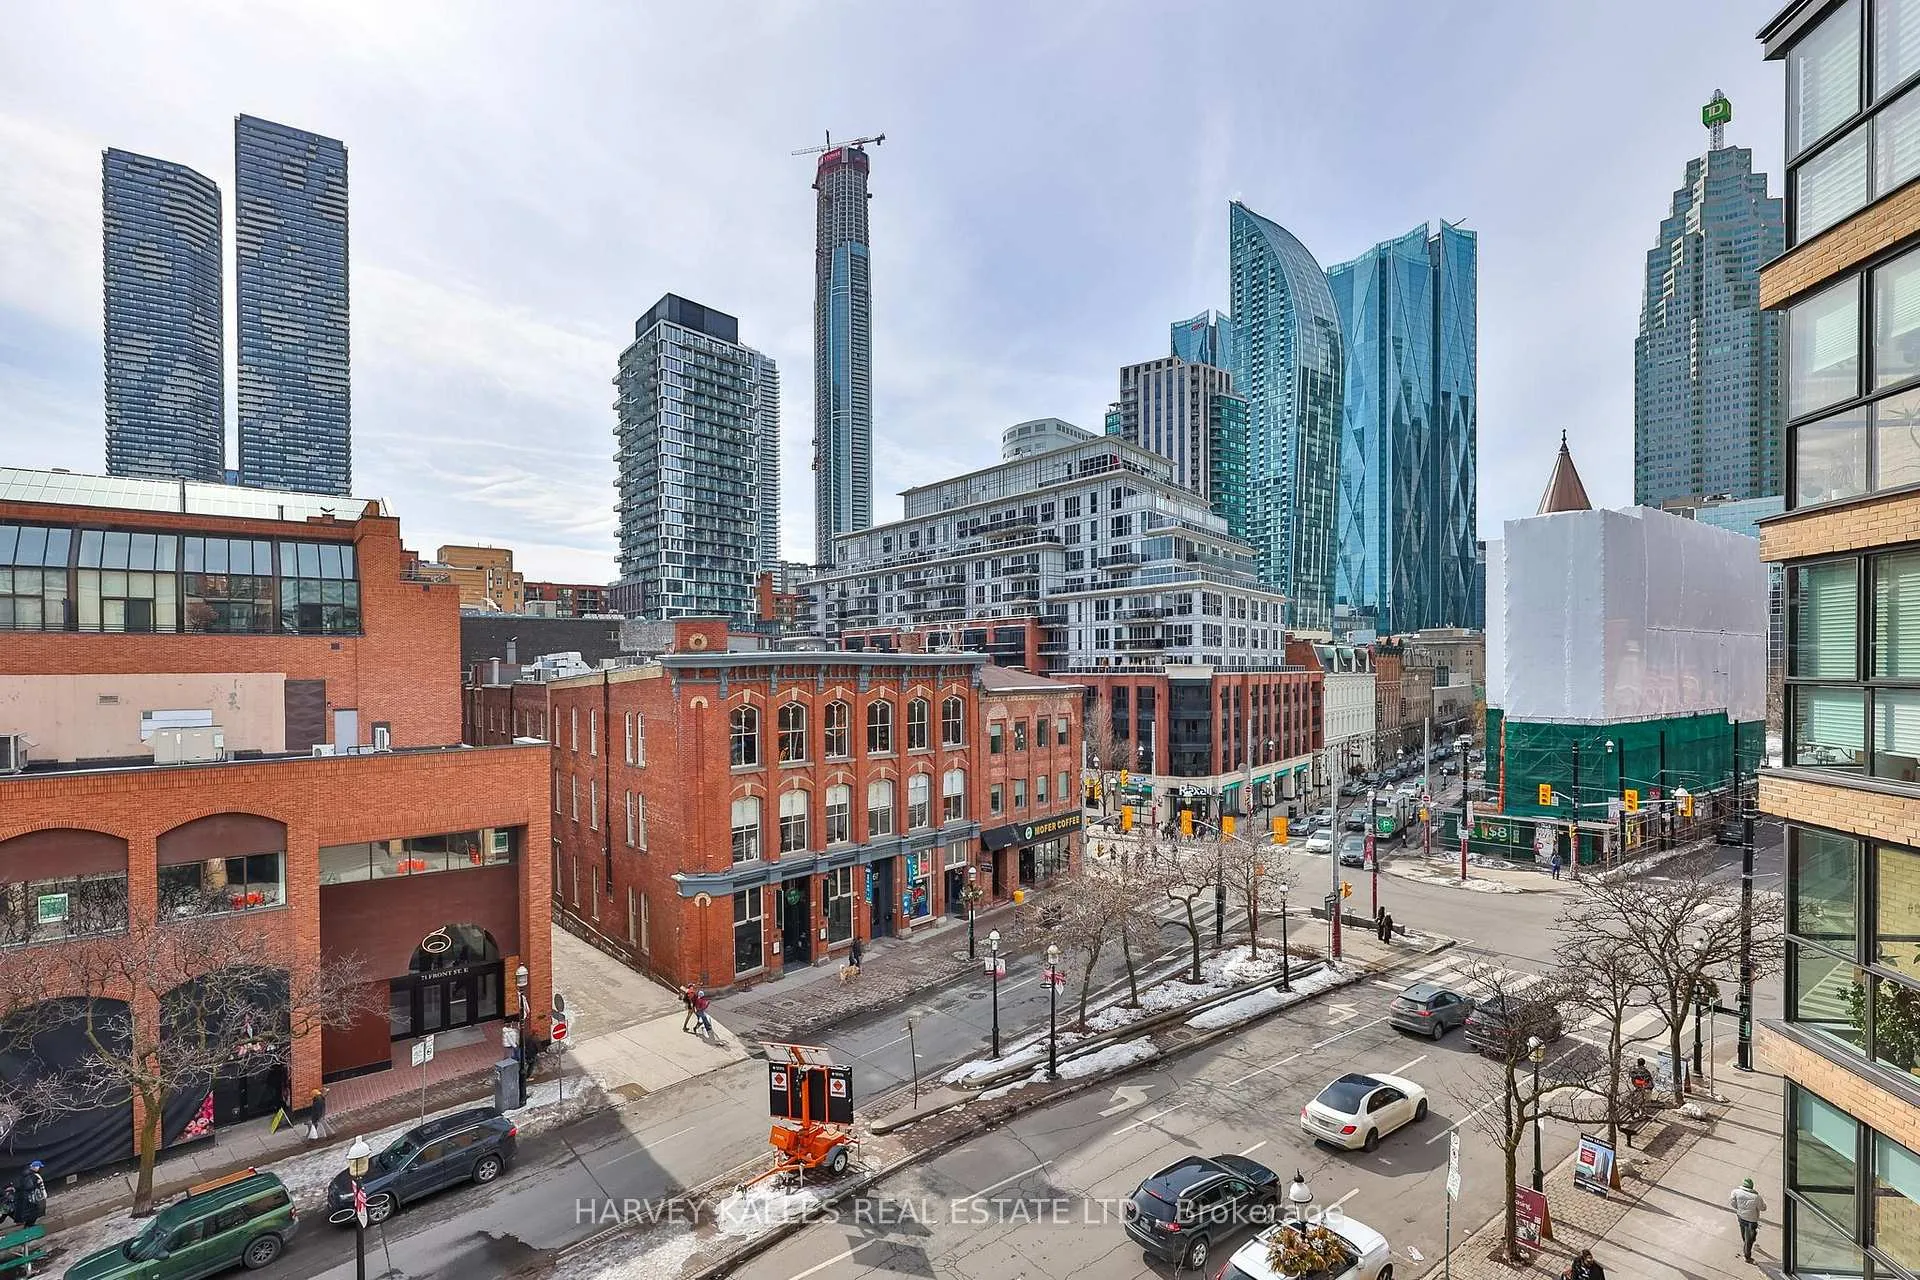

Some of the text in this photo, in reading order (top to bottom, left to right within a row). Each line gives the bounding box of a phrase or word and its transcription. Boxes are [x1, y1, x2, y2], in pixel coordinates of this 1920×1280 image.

[1704, 102, 1724, 118] TD
[1057, 815, 1080, 829] COFFEE
[428, 971, 452, 979] FRONT
